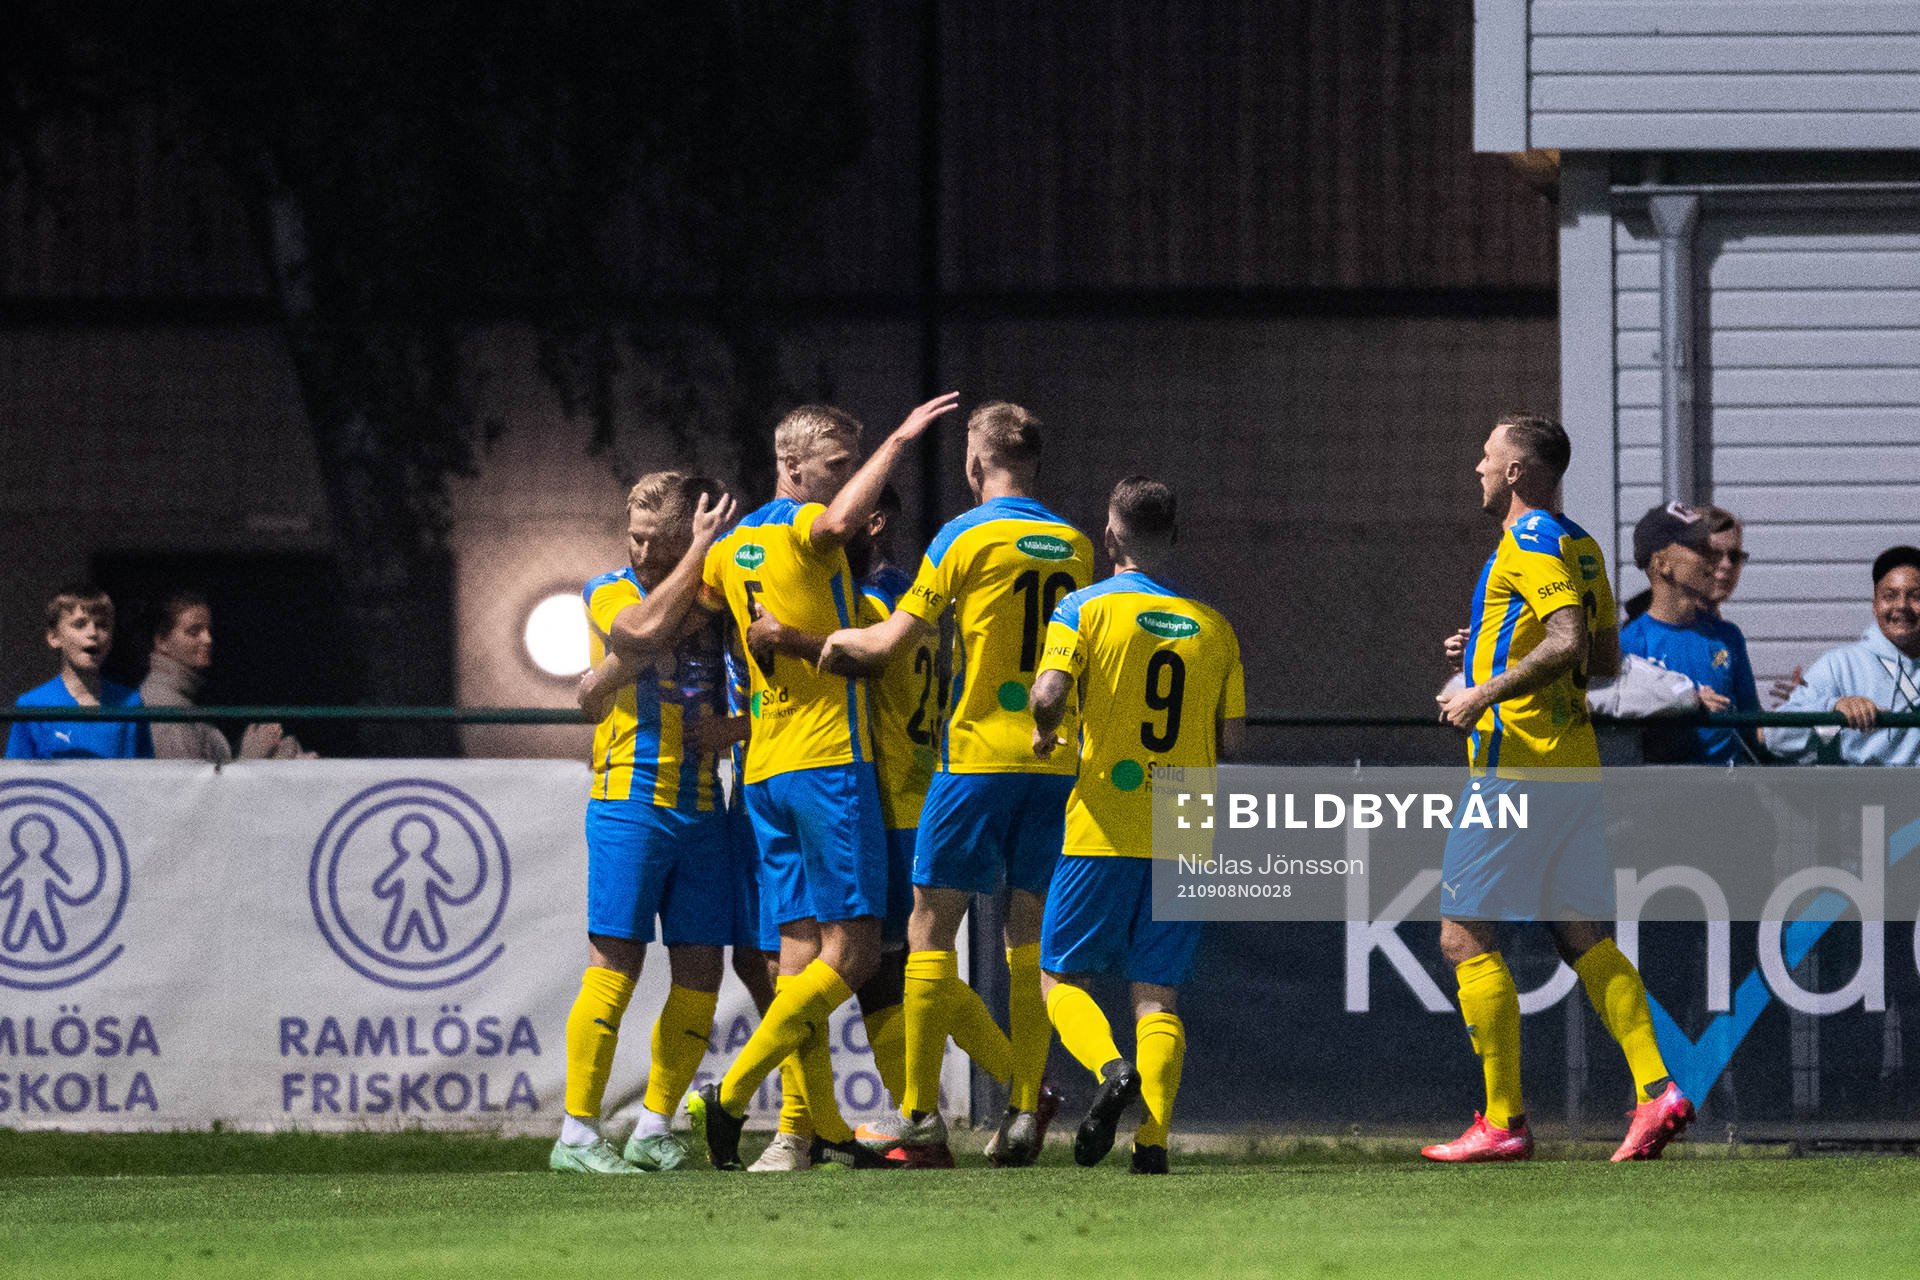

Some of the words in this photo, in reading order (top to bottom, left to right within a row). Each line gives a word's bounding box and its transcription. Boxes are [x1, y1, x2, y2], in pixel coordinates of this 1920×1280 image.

[1140, 650, 1185, 753] 9
[279, 1004, 541, 1057] RAMLÖSA
[281, 1071, 541, 1113] FRISKOLA
